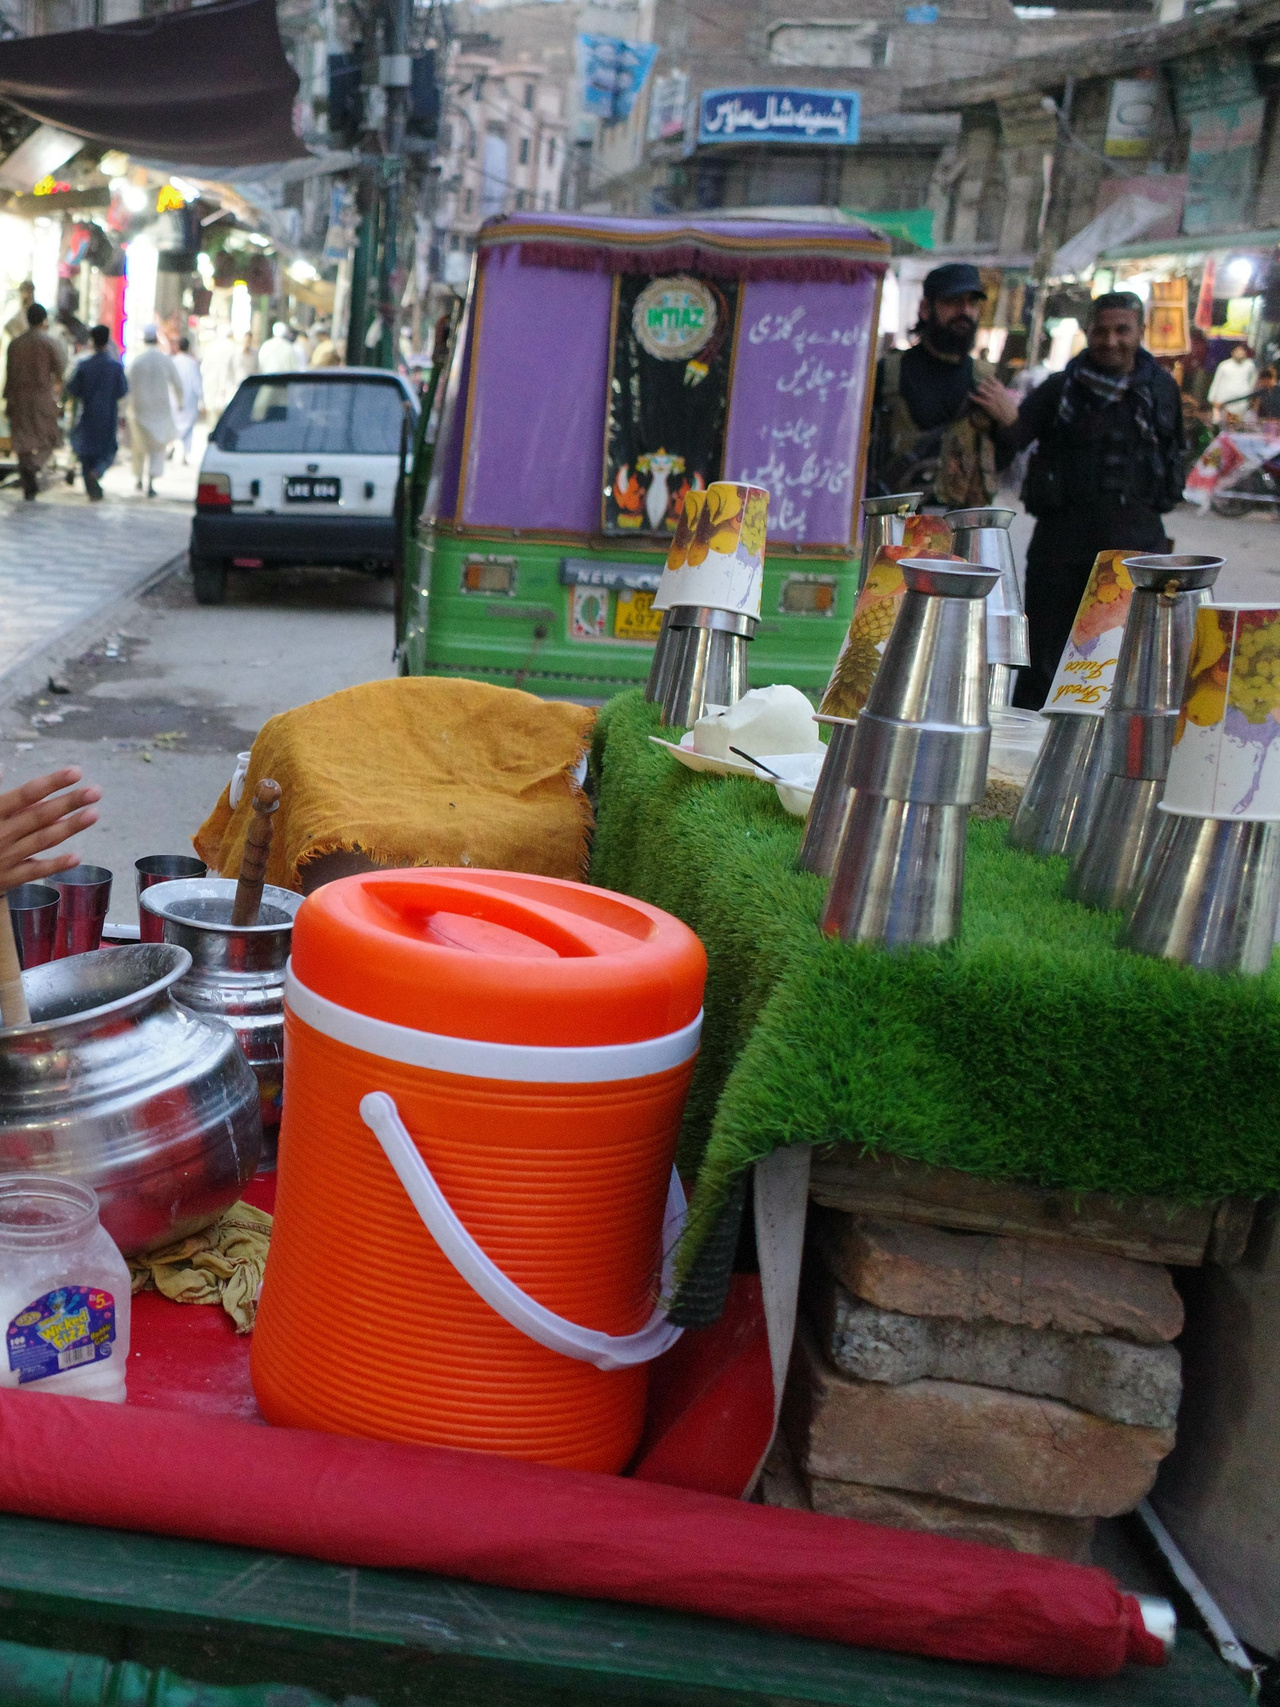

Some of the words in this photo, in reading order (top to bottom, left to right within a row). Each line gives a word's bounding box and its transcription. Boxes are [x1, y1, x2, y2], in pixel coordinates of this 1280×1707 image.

[1063, 658, 1118, 680] Juice
[1051, 684, 1109, 704] Fresh
[95, 1293, 106, 1310] 5
[40, 1308, 88, 1341] Wicked
